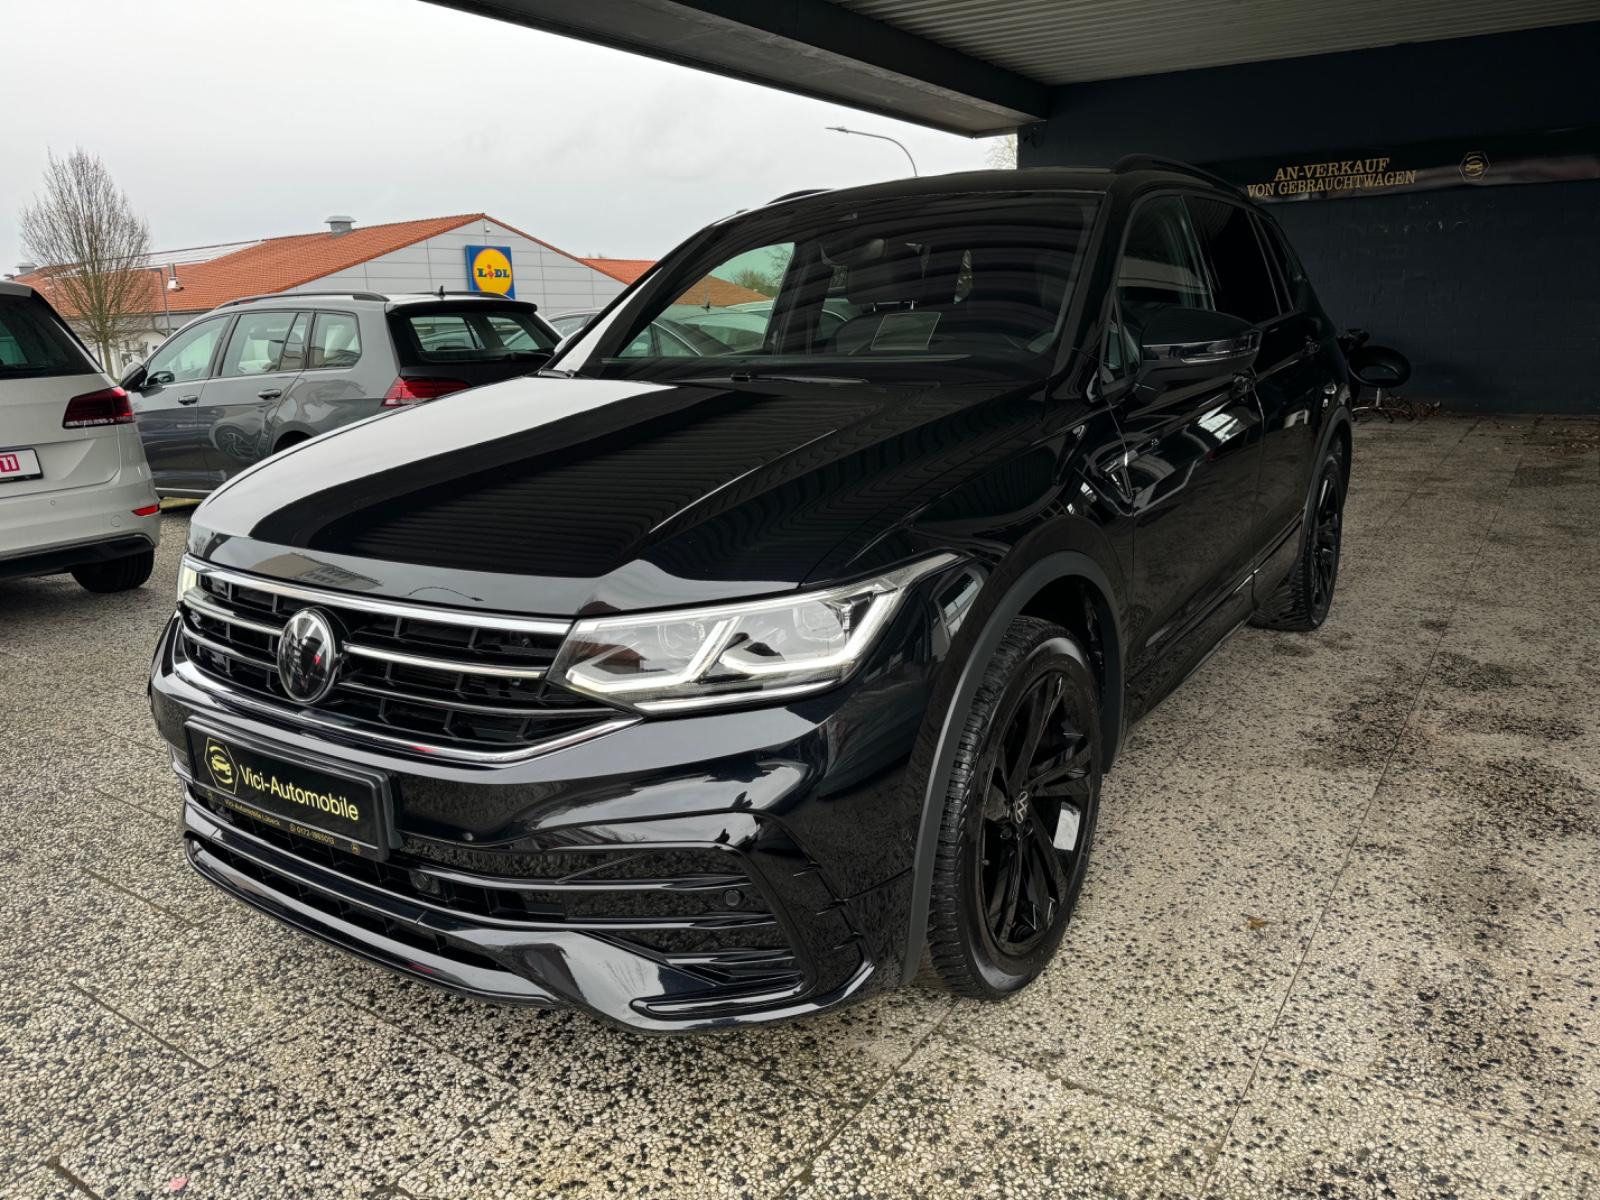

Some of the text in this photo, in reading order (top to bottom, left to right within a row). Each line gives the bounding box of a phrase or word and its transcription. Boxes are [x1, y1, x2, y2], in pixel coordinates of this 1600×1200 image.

[1274, 157, 1390, 182] AN-VERKAUF
[1247, 170, 1417, 198] VON GEBRAUCHTWAGEN
[476, 264, 510, 280] LIDL
[239, 764, 359, 821] Vici-Automobile
